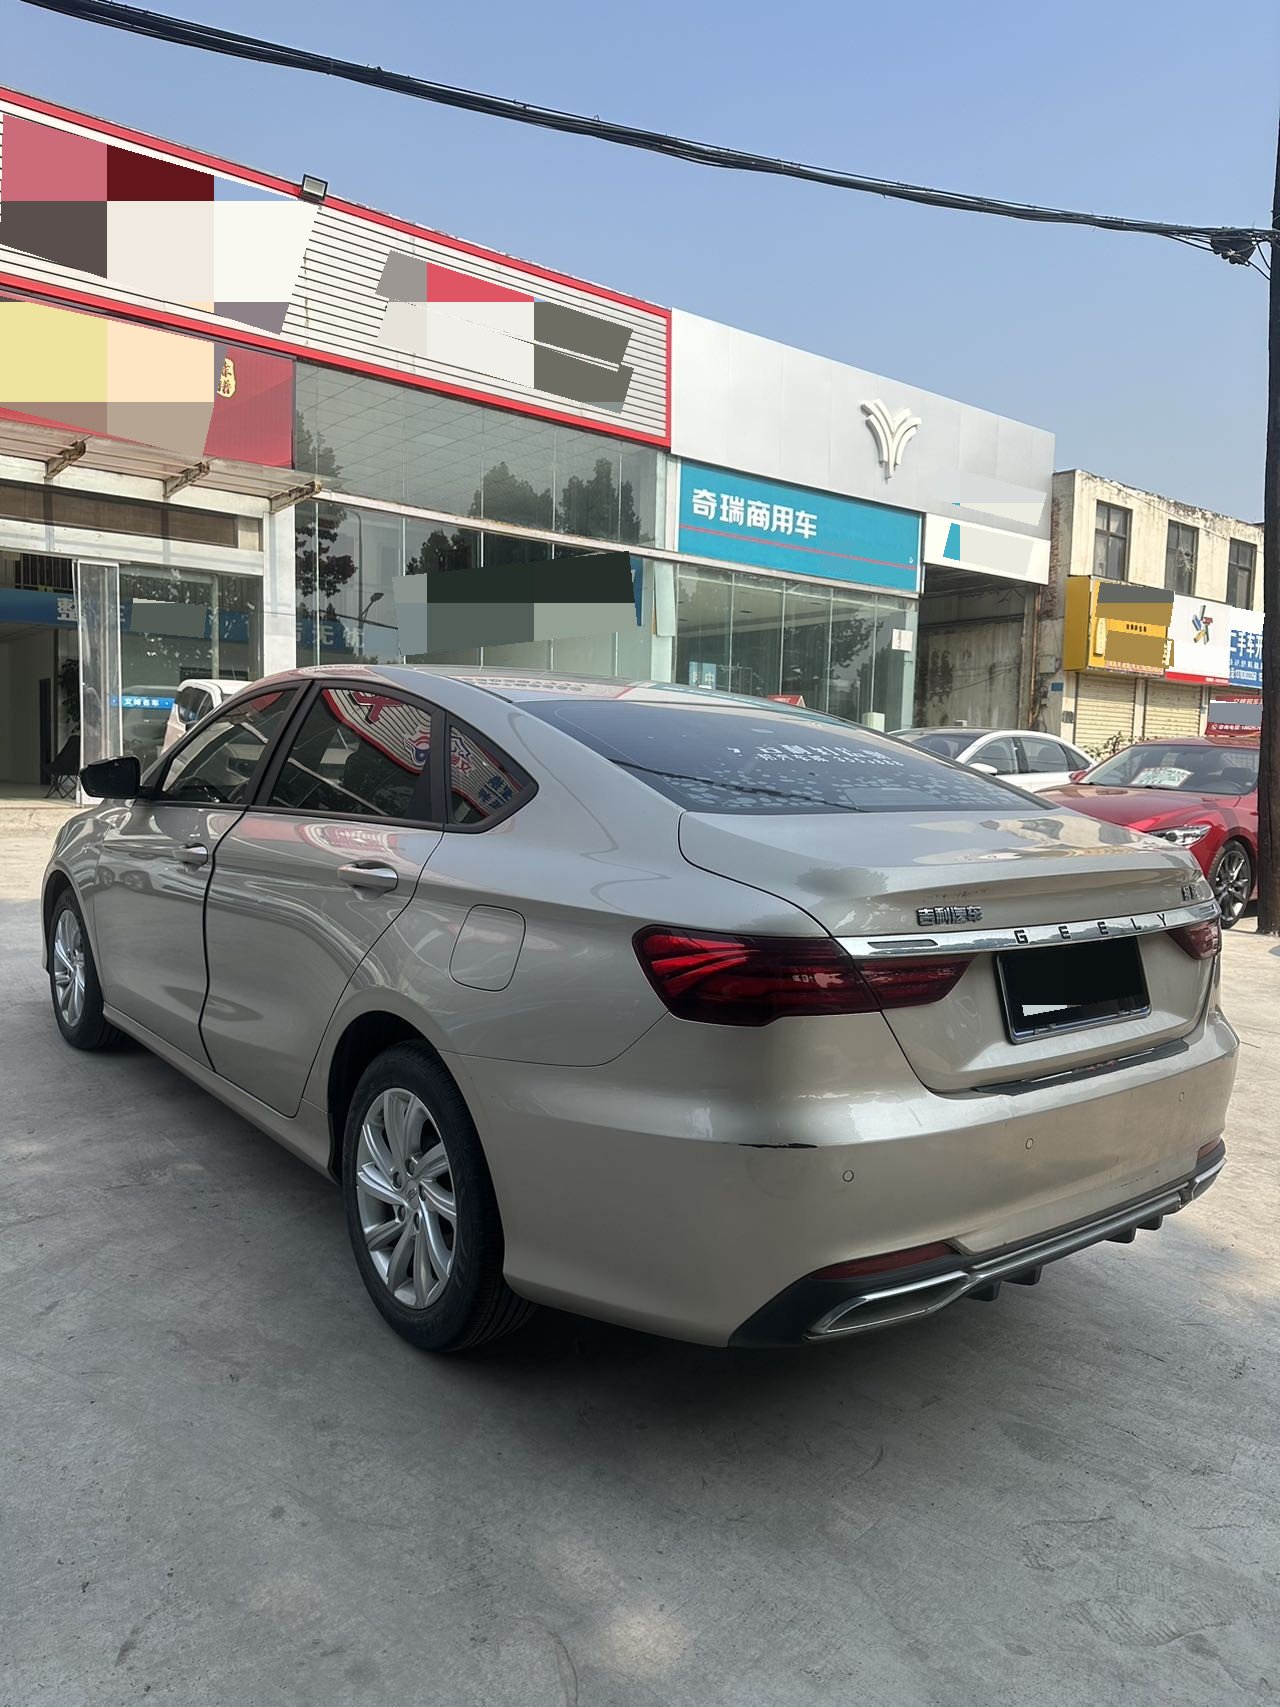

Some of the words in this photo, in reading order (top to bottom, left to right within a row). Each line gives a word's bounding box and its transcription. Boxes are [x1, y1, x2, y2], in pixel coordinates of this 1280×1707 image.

[692, 488, 817, 539] 奇瑞商用车
[916, 905, 983, 927] 吉利汽车
[1015, 913, 1170, 944] GEELY
